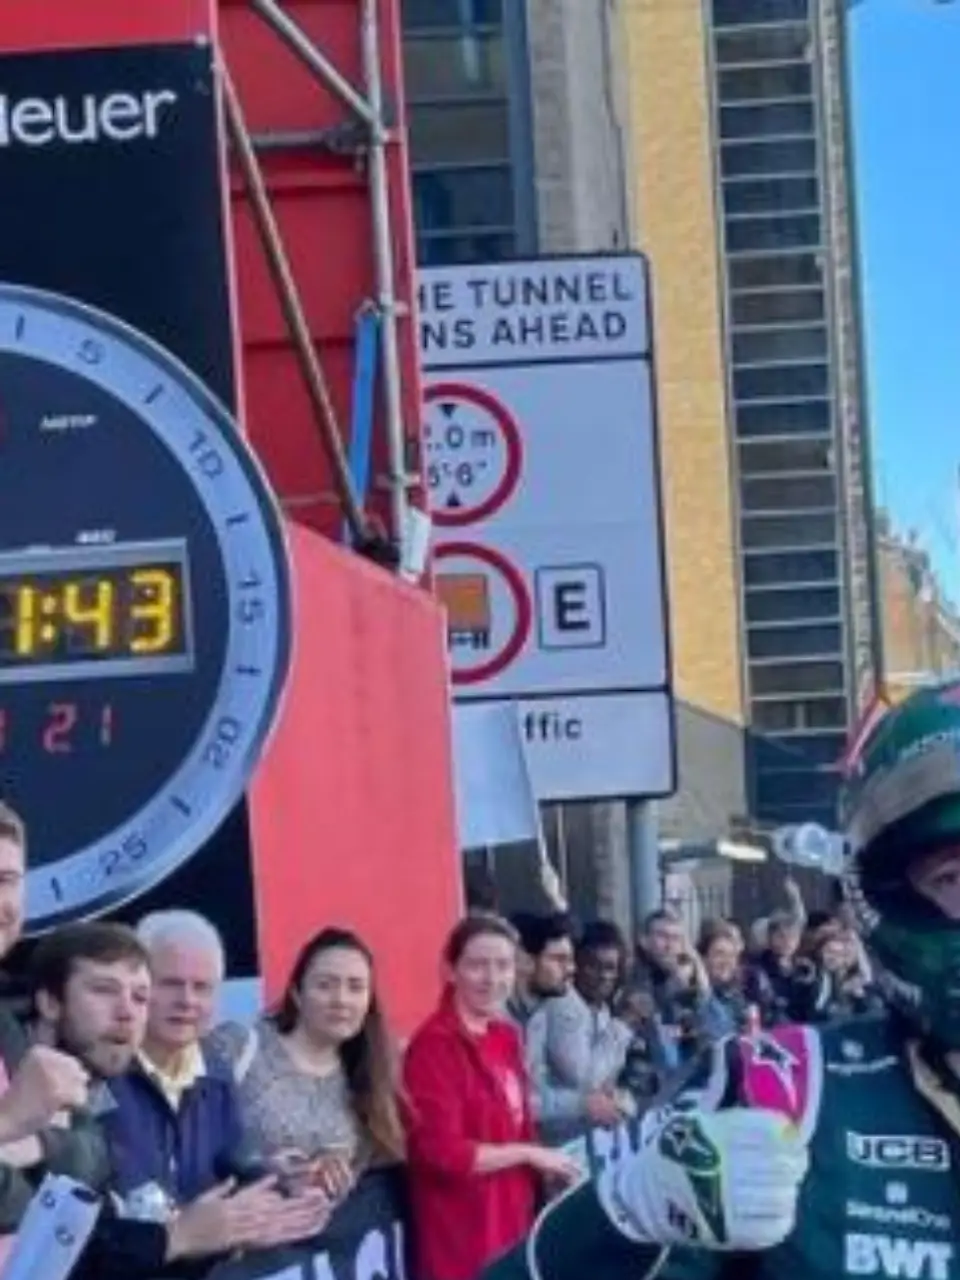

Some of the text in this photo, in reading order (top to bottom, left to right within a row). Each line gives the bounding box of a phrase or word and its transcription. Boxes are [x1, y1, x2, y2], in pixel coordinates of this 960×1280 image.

[0, 88, 177, 147] euer
[466, 272, 634, 308] TUNNEL
[421, 311, 627, 350] NS AHEAD
[554, 581, 591, 631] E
[524, 711, 583, 742] ffic
[856, 1136, 946, 1166] JCB
